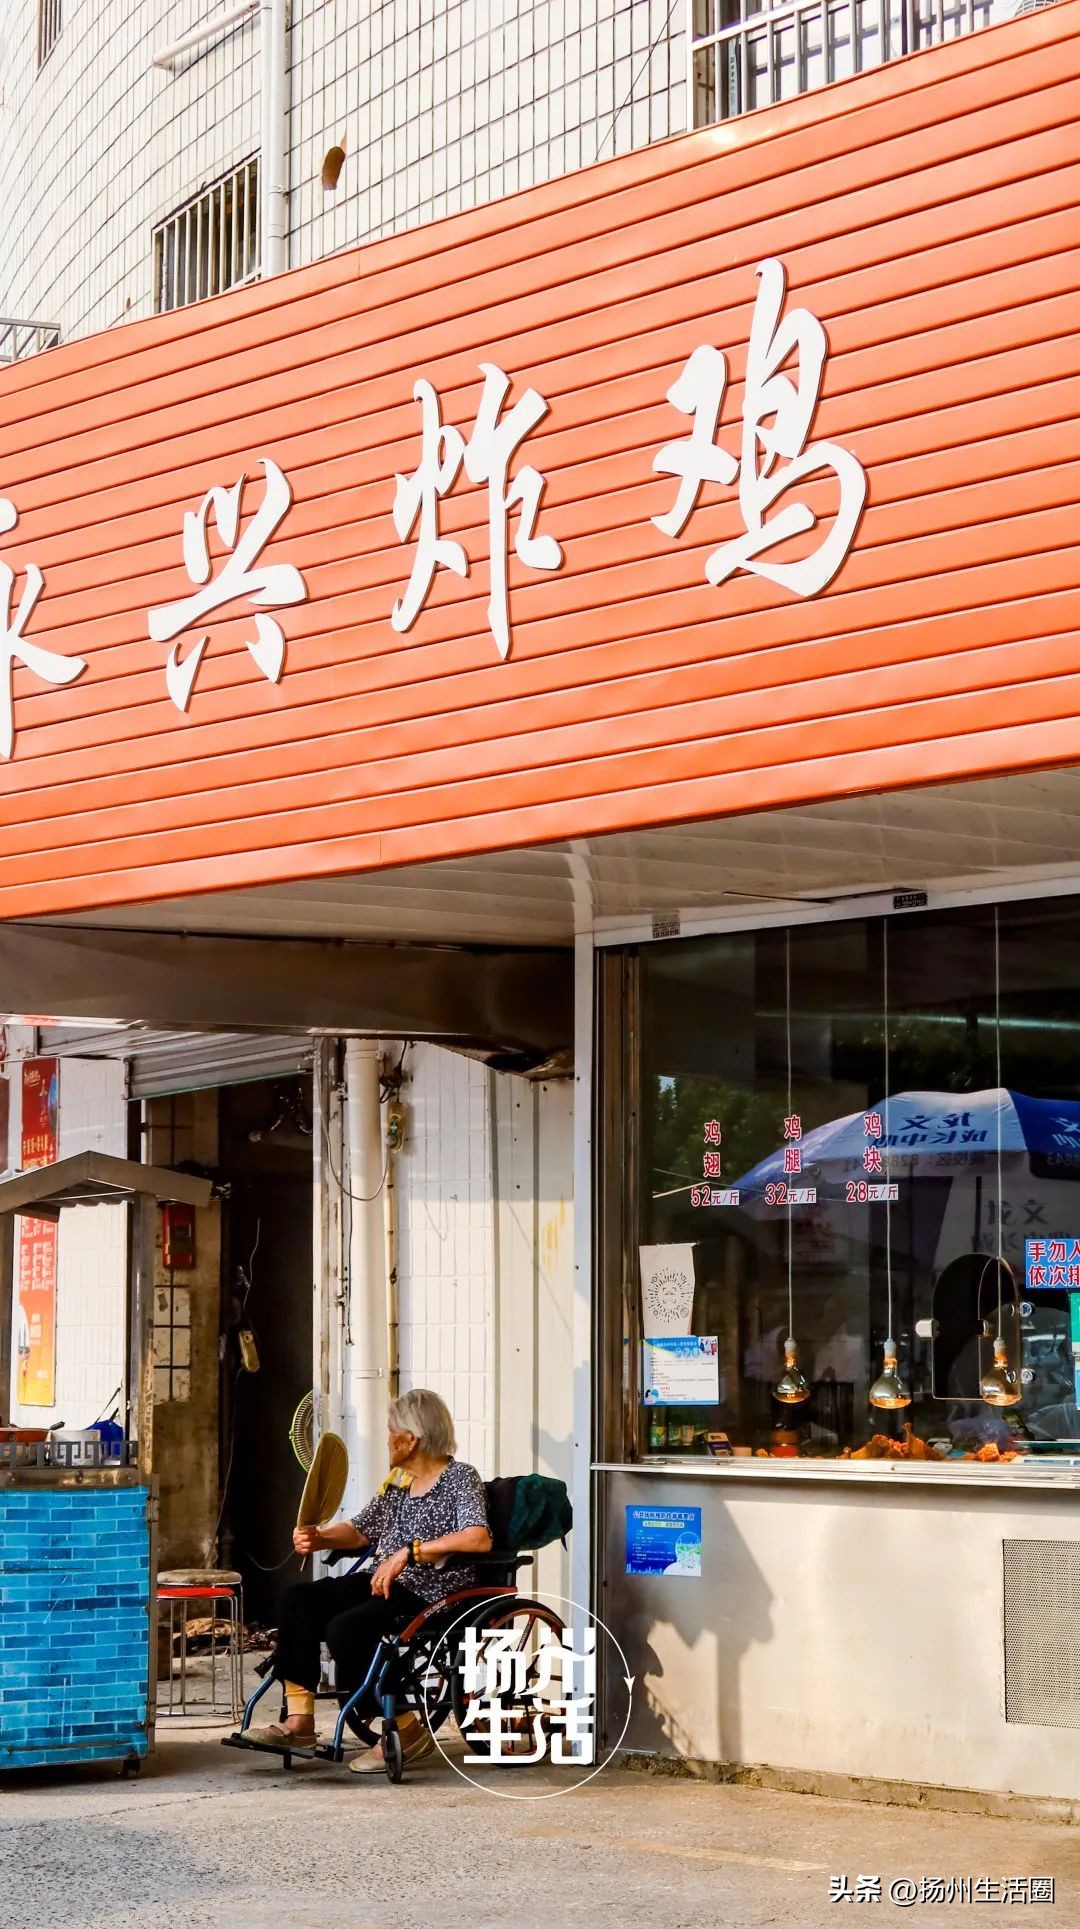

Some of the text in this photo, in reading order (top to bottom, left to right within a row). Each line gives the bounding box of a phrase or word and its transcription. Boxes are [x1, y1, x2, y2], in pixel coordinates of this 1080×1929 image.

[704, 1119, 721, 1178] 鸡翅
[784, 1114, 802, 1174] 鸡腿
[864, 1111, 882, 1174] 鸡块
[691, 1185, 740, 1207] 52元/斤
[765, 1182, 817, 1206] 32元/斤
[845, 1180, 899, 1204] 28元/斤
